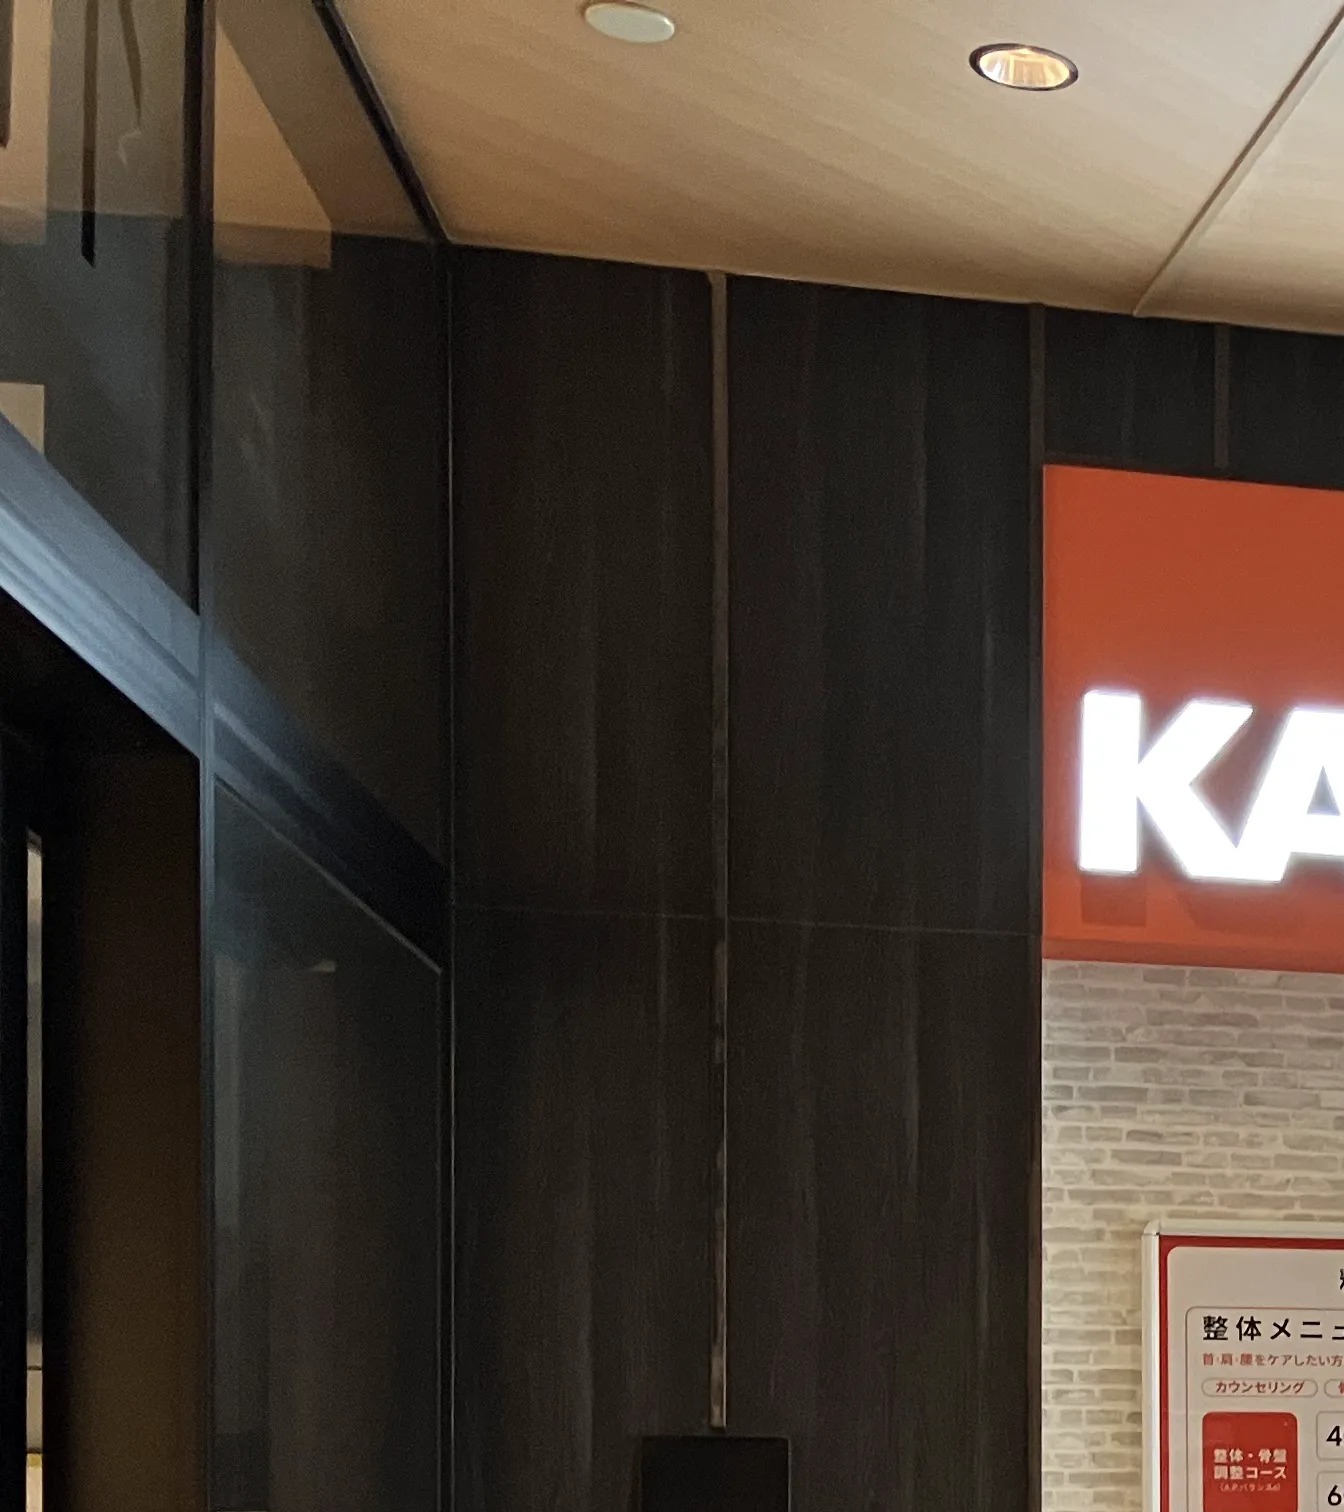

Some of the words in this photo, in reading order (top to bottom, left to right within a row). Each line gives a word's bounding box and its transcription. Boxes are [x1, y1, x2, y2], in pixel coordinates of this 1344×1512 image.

[1215, 1380, 1305, 1395] カウンセリング
